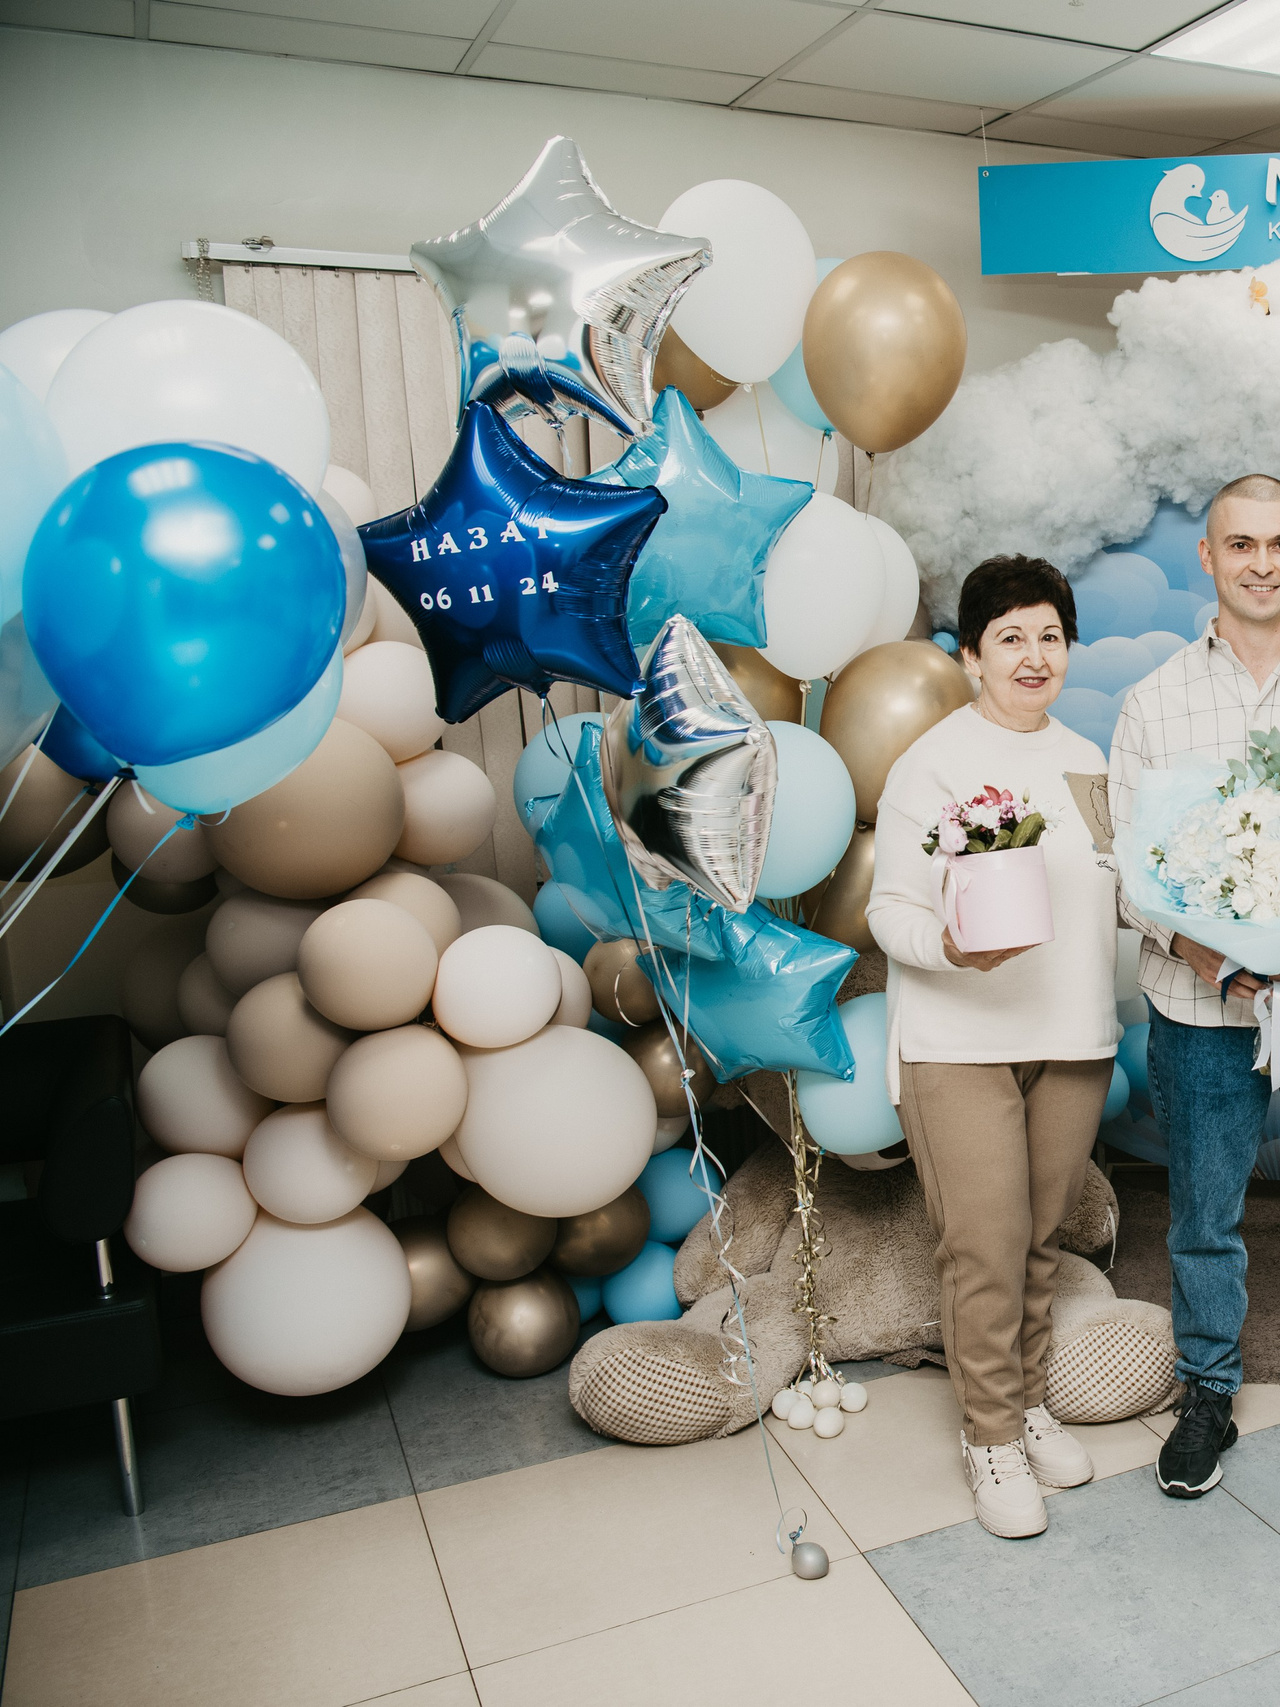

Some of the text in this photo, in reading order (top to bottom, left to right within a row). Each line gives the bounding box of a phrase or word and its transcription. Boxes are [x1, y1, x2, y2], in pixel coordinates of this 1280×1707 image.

[420, 571, 559, 610] 06 11 24
